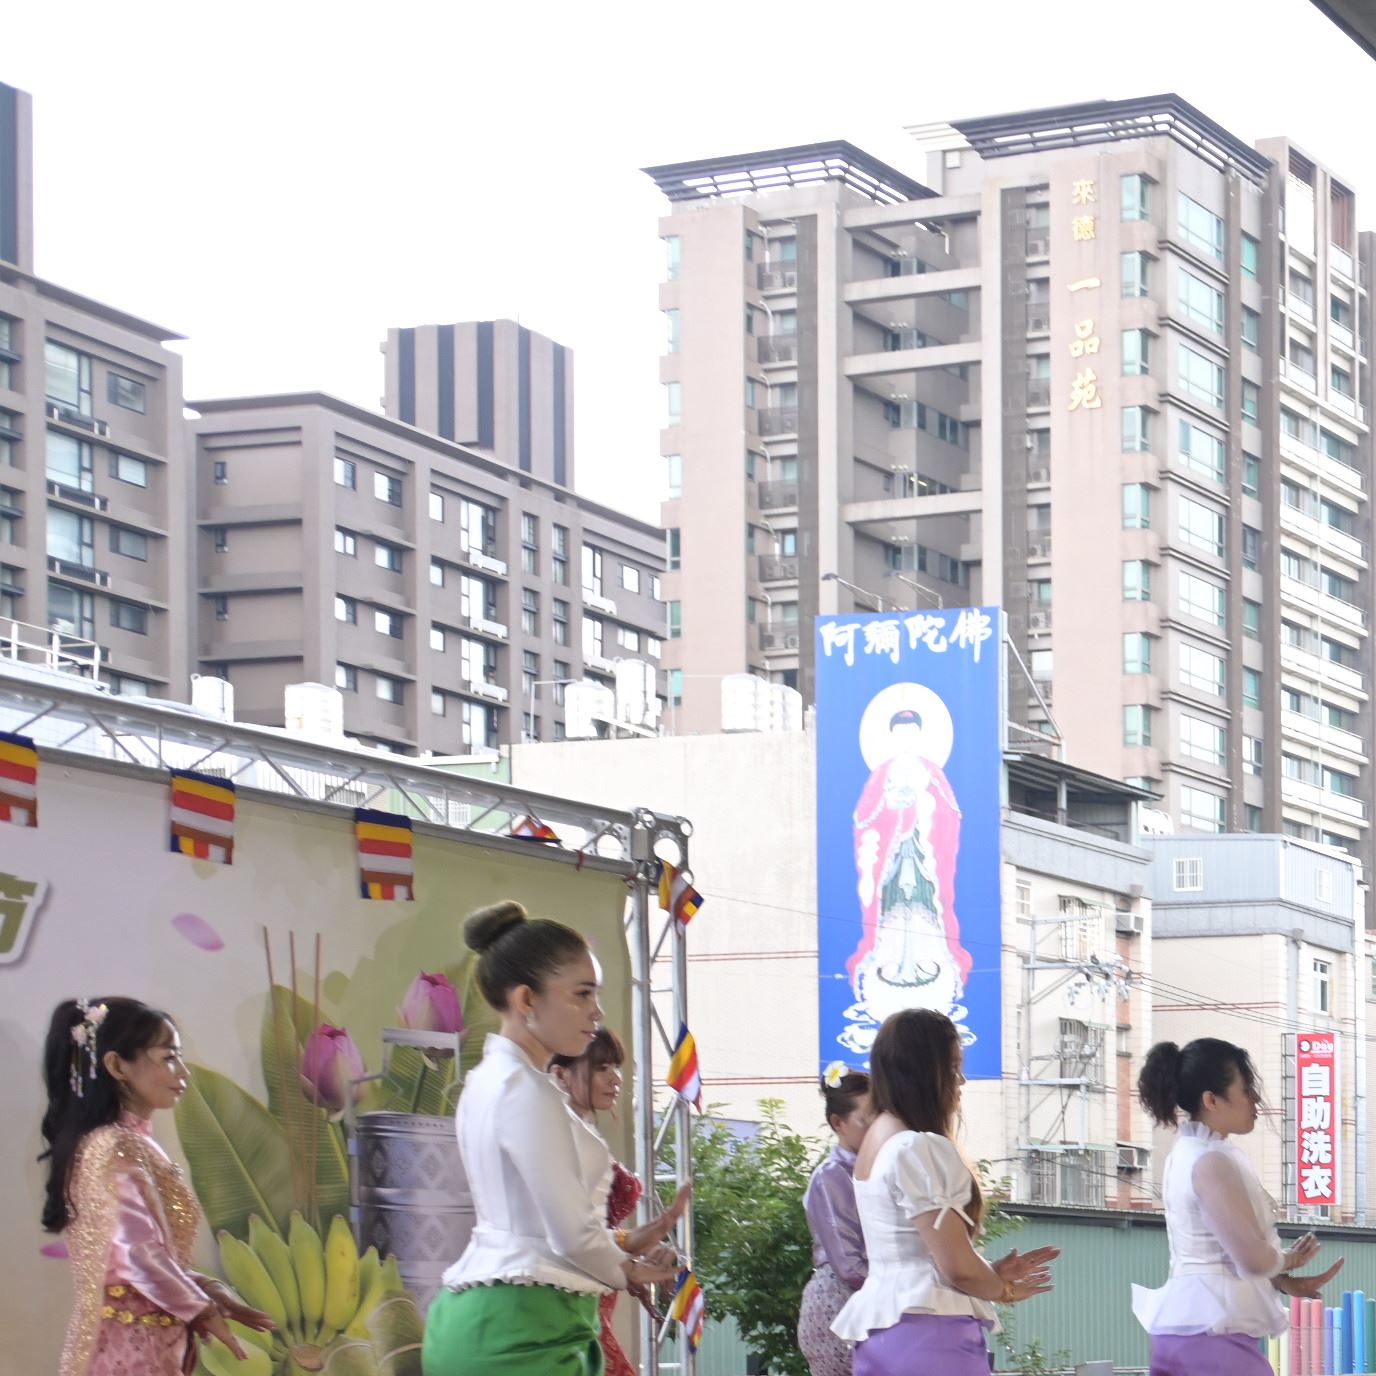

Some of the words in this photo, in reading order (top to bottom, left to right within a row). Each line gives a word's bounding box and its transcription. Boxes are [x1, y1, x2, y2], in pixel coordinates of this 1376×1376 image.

[819, 608, 993, 667] 阿彌陀佛
[1300, 1063, 1333, 1199] 自助洗衣
